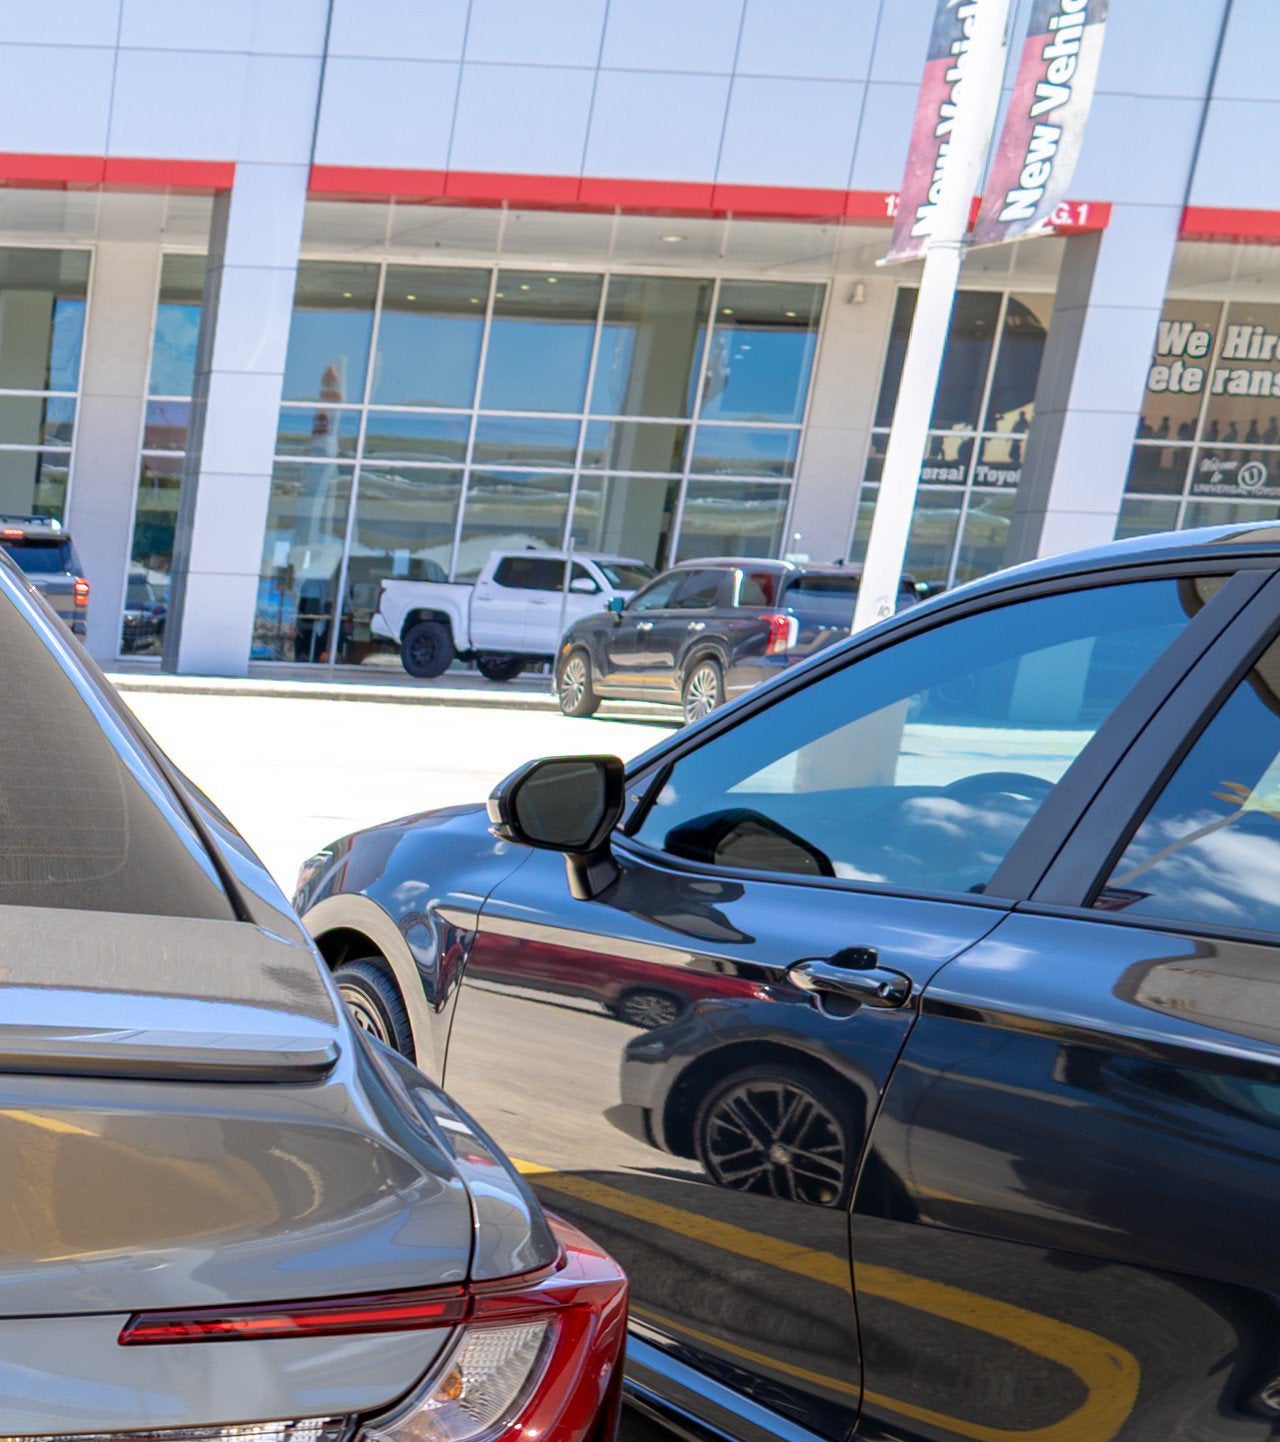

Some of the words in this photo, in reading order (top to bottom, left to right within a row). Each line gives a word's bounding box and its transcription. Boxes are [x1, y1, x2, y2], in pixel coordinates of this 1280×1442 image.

[999, 124, 1062, 222] New
[1156, 320, 1212, 358] We
[1221, 323, 1280, 361] Hir
